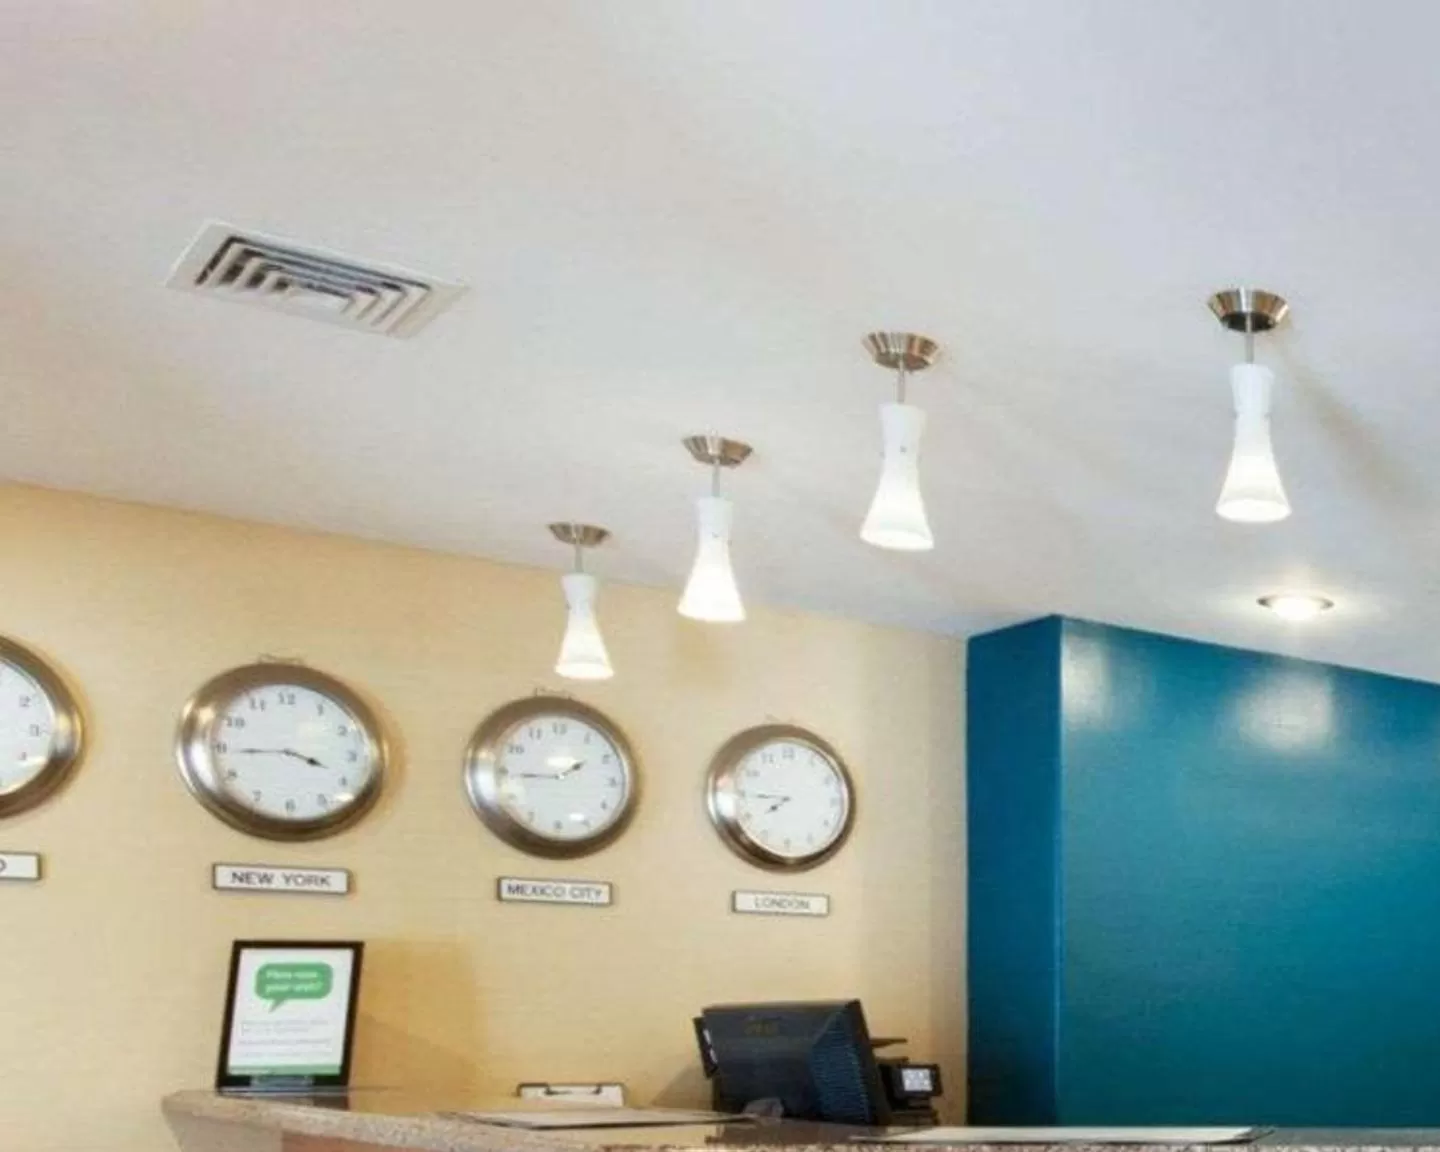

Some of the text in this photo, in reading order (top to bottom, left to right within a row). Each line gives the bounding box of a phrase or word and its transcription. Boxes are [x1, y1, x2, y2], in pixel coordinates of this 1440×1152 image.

[278, 692, 295, 705] 12
[230, 871, 332, 887] NEW YORK
[506, 883, 603, 901] MEXICO CITY
[754, 896, 809, 910] LONDON
